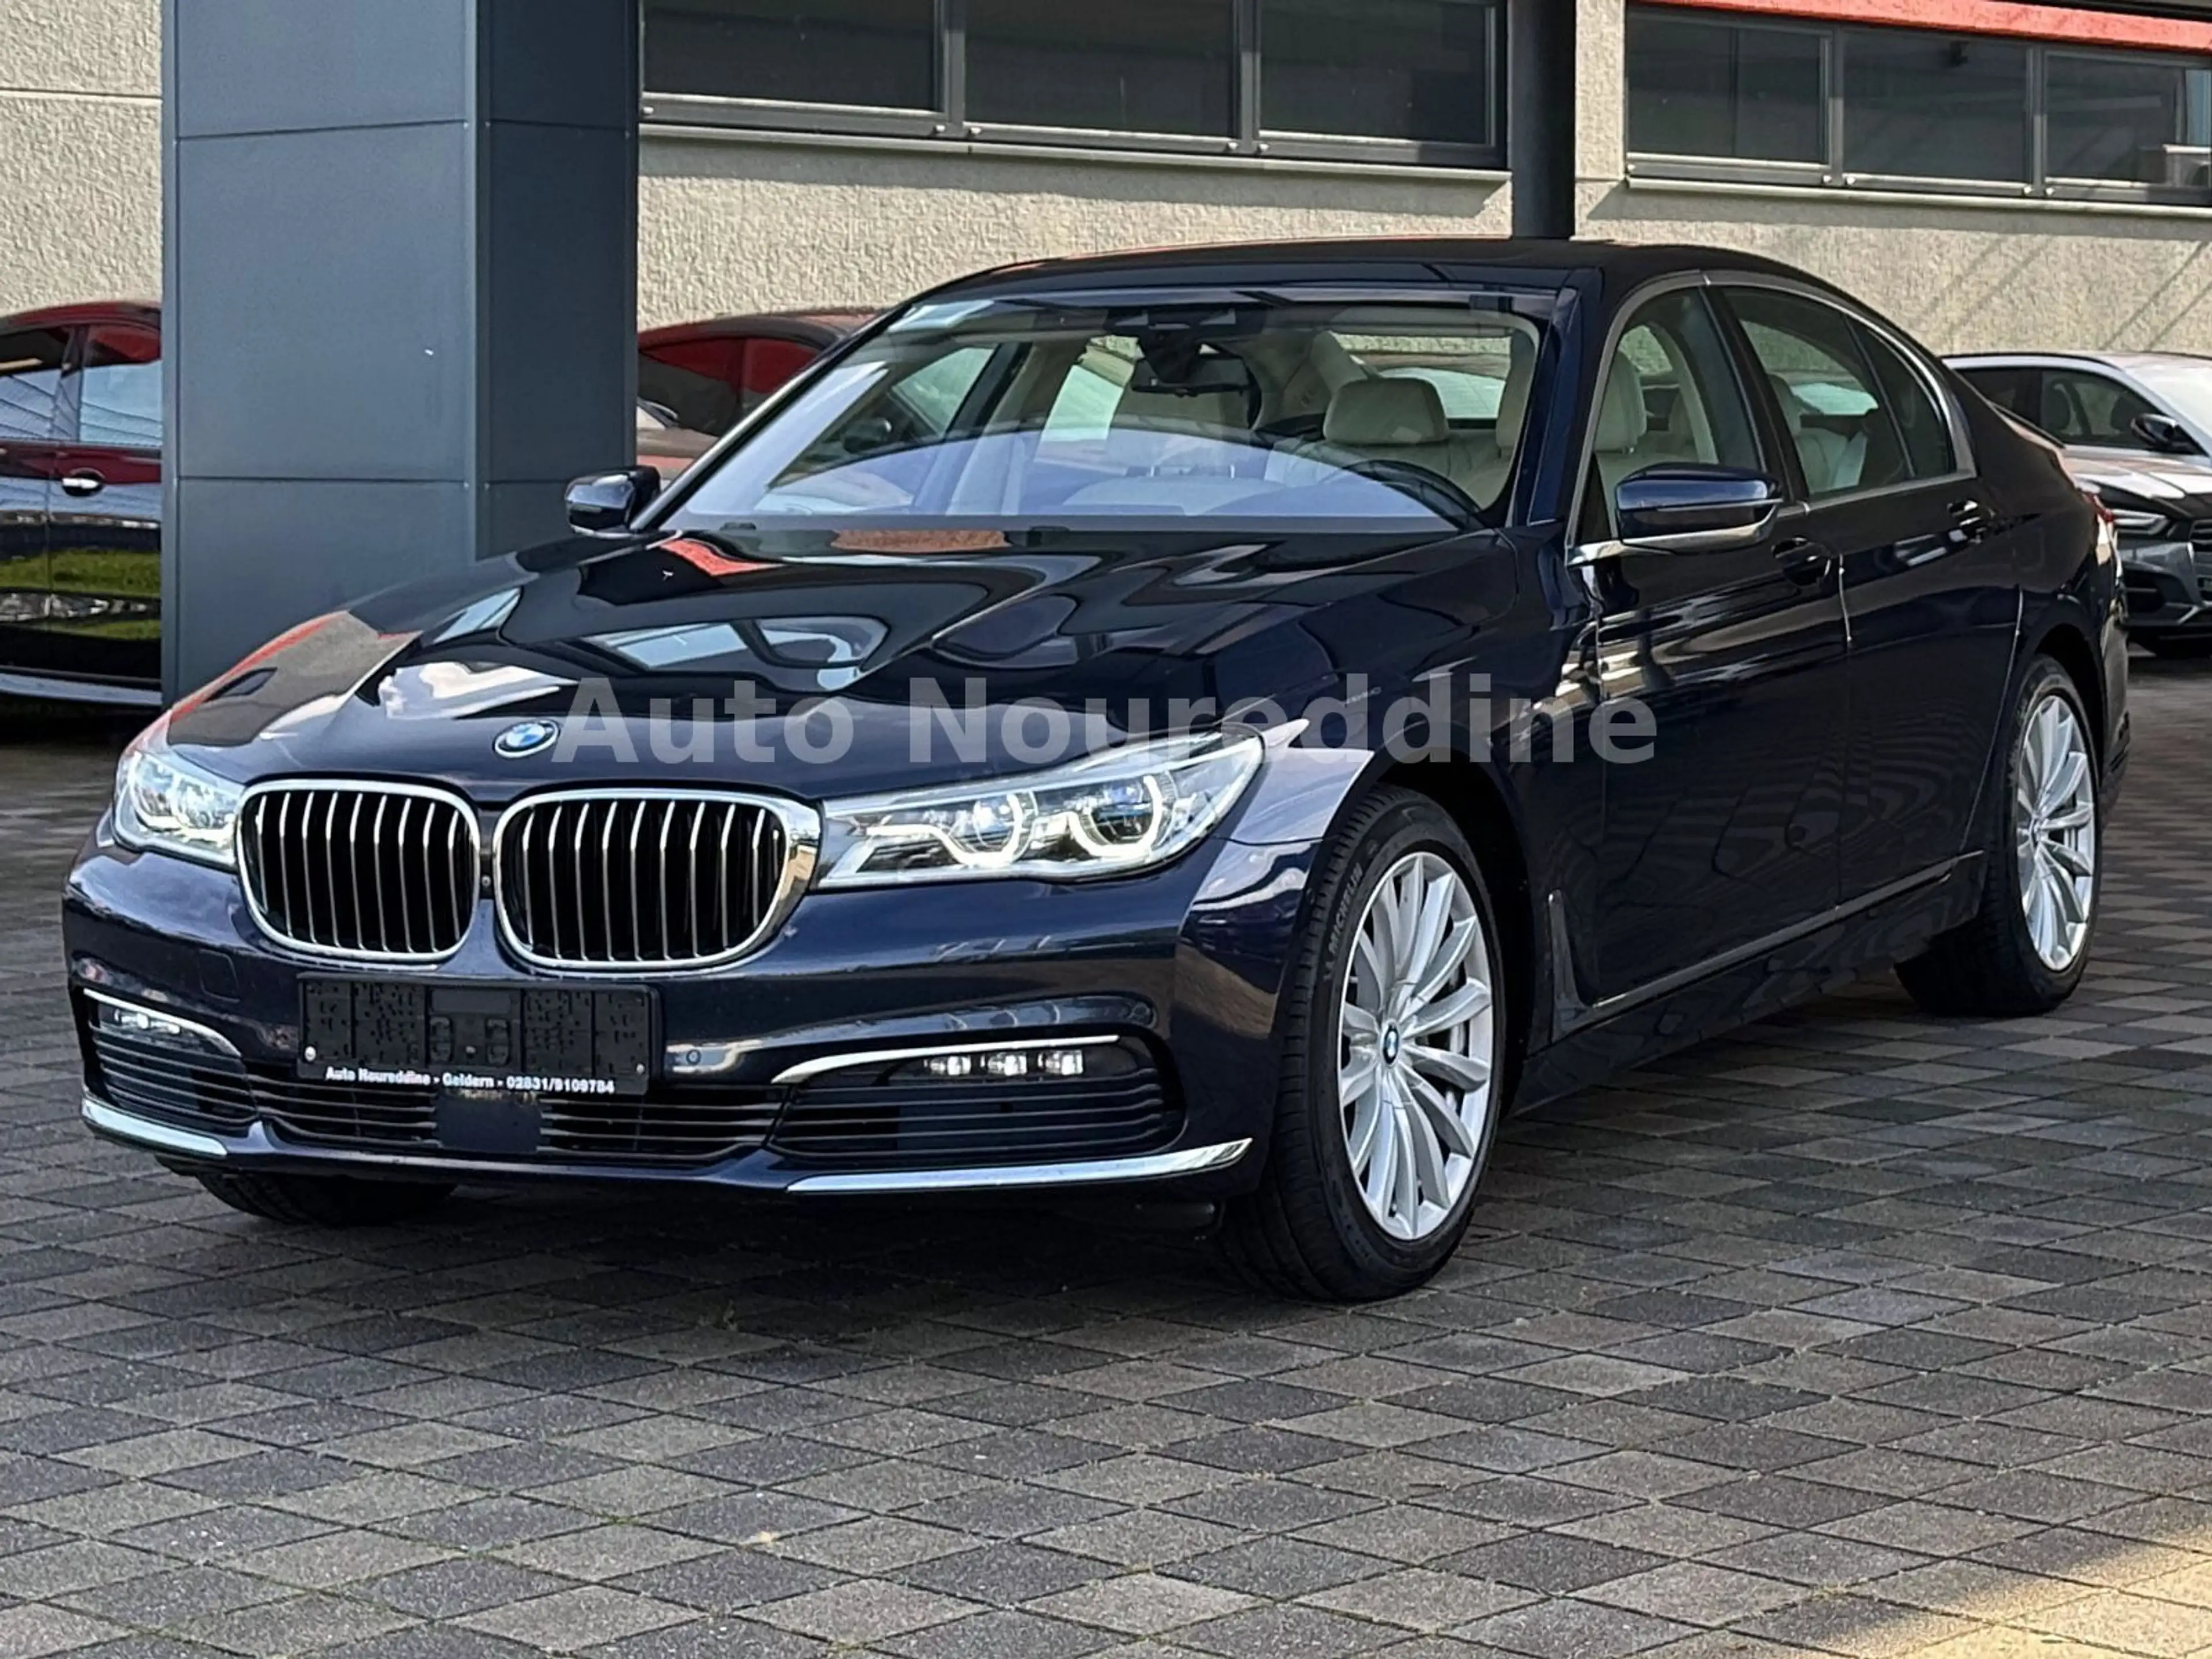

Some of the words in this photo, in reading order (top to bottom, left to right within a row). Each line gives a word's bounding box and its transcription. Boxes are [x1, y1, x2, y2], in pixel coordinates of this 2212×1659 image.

[325, 1066, 356, 1081] Auto
[358, 1067, 431, 1085] Noureddine
[442, 1072, 494, 1087] Geldern
